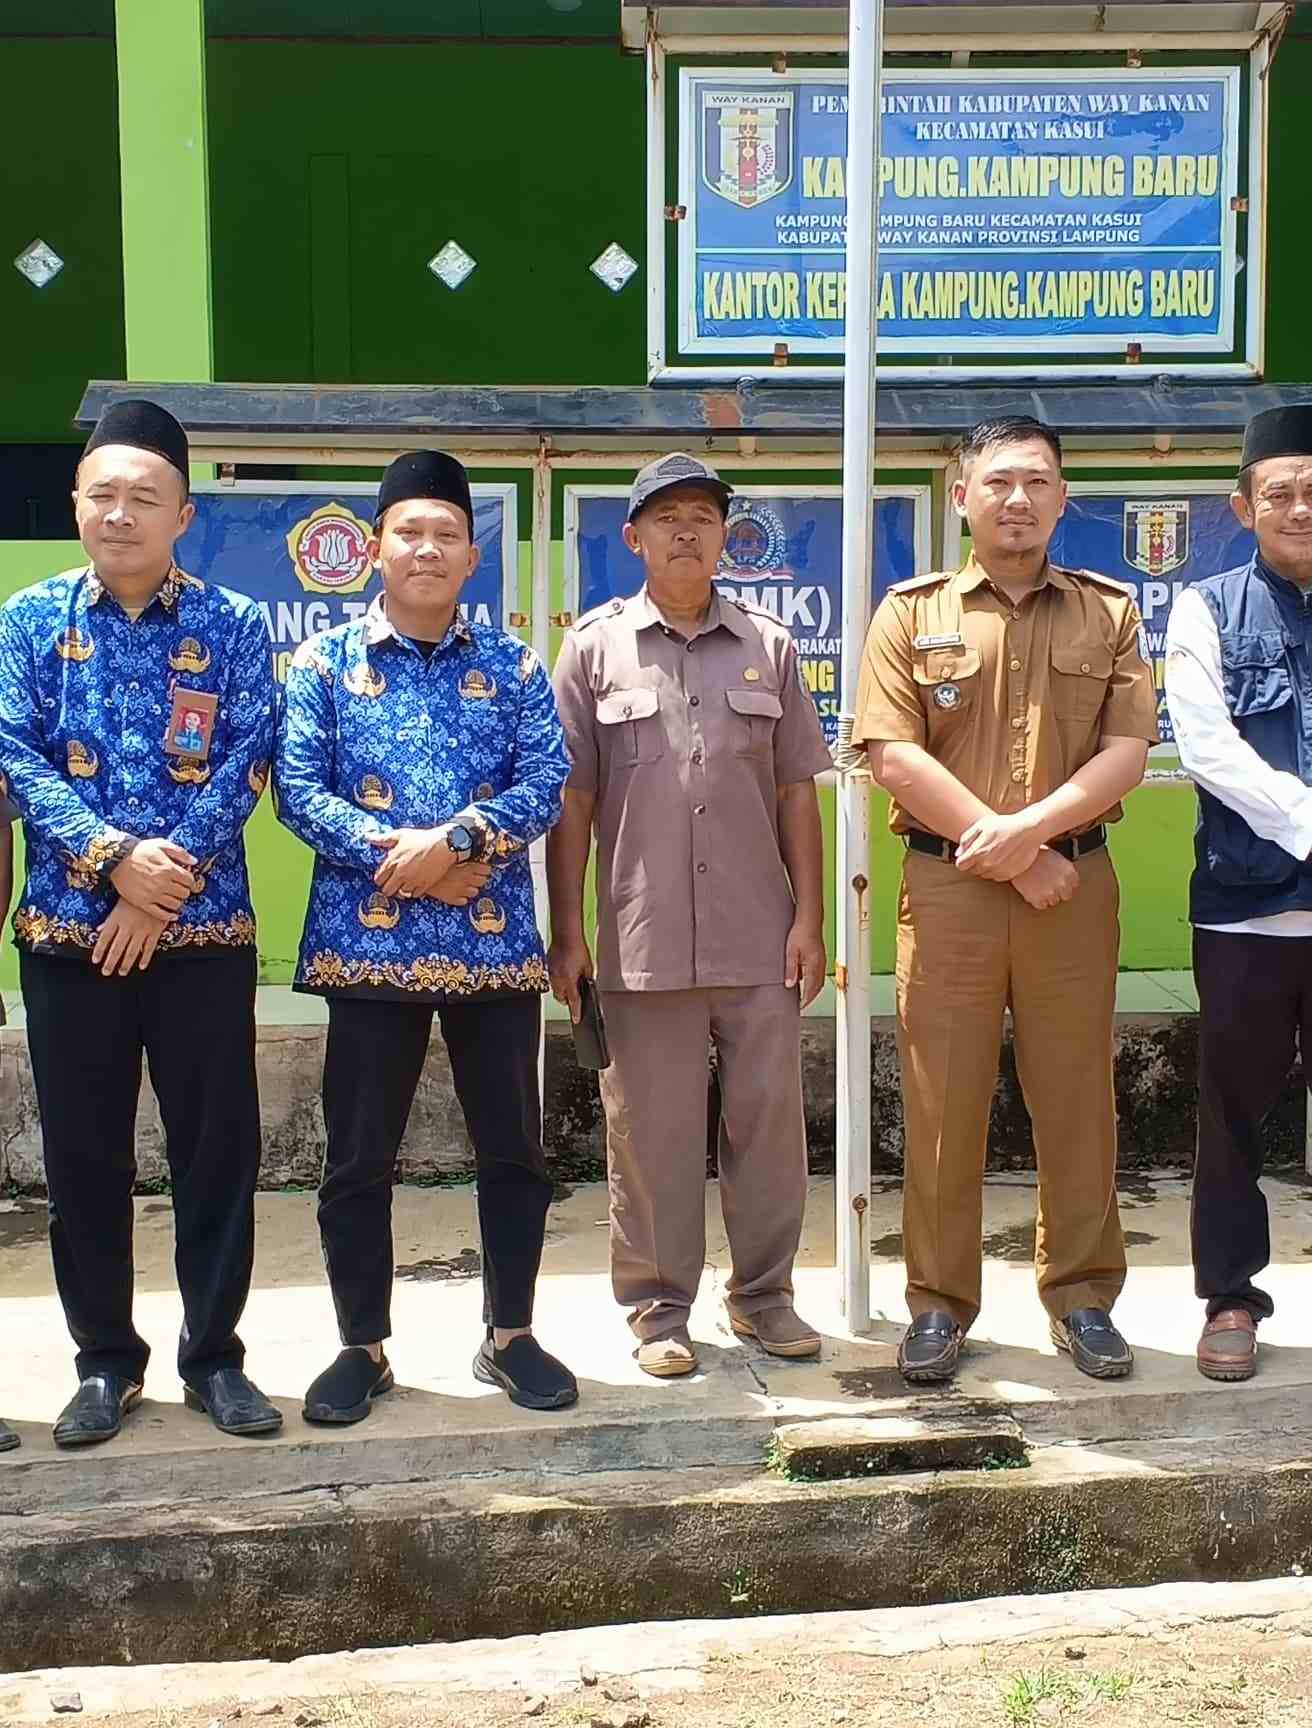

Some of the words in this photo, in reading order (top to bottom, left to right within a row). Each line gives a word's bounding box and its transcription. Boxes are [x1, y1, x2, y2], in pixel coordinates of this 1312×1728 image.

[711, 96, 738, 104] WAY
[741, 96, 785, 104] KANAN
[958, 95, 1081, 113] KABUPATEN
[1088, 94, 1135, 112] WAY
[1139, 94, 1210, 111] KANAN
[915, 121, 1038, 140] KECAMATAN
[1044, 121, 1105, 139] KASUI
[803, 155, 1125, 198] KAPUNG.KAMPUNG
[1132, 154, 1218, 196] BARU
[942, 214, 985, 227] BARU
[990, 214, 1087, 227] KECAMATAN
[1092, 213, 1143, 226] KASUI
[878, 231, 913, 244] WAY
[917, 231, 973, 243] KANAN
[978, 230, 1058, 243] PROVINSI
[1062, 230, 1140, 242] LAMPUNG
[703, 271, 801, 320] KANTOR
[1150, 270, 1215, 317] BARU
